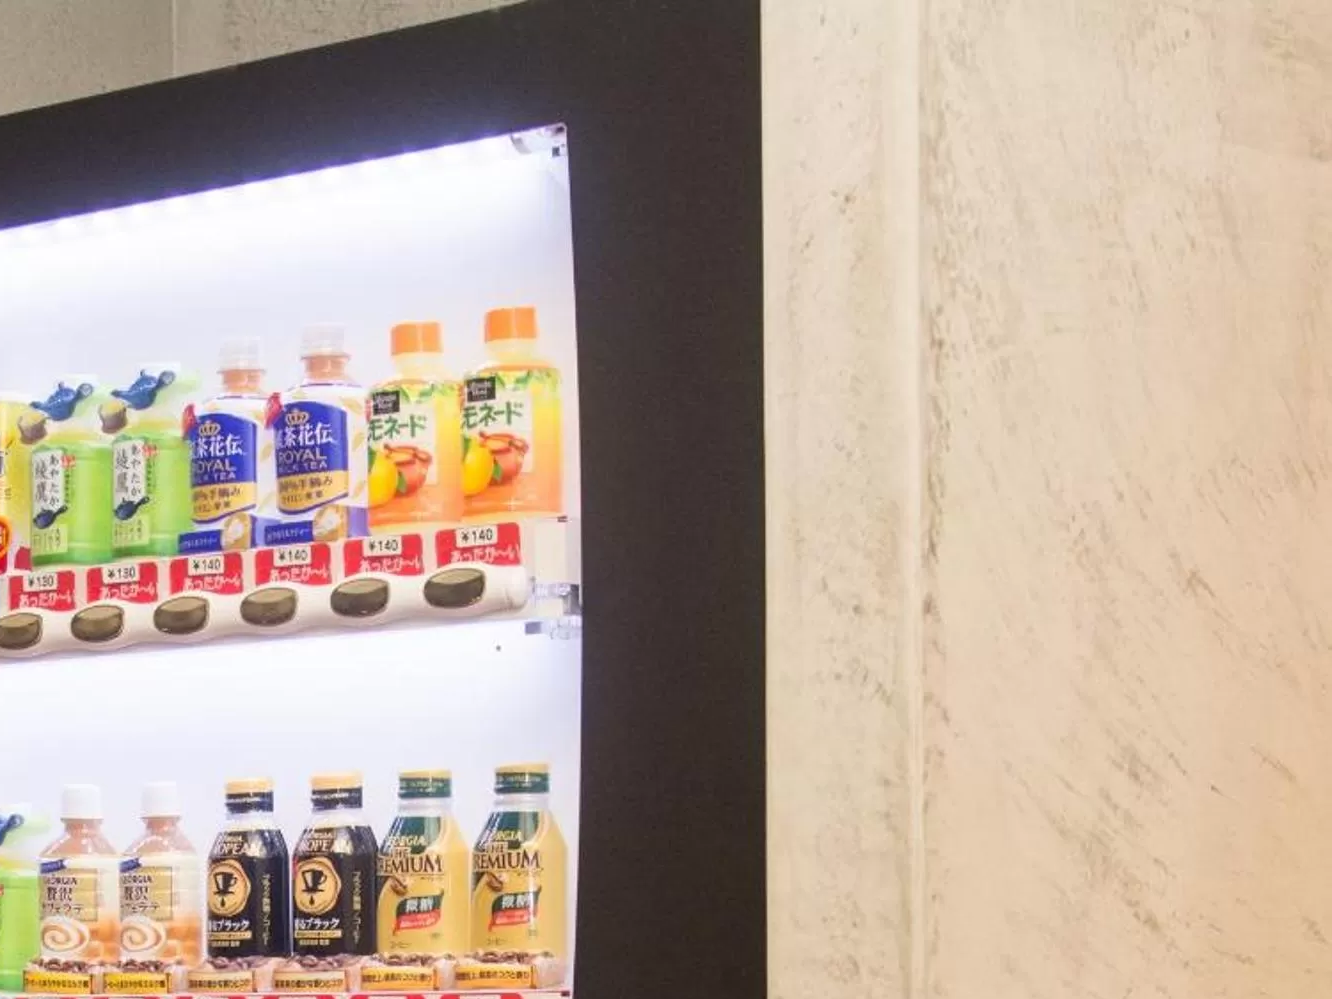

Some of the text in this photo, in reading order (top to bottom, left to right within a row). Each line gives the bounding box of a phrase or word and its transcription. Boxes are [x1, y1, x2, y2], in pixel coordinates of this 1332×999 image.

[460, 528, 494, 543] ¥140
[368, 539, 399, 552] ¥140
[278, 549, 308, 562] ¥140
[192, 558, 221, 571] ¥140
[107, 567, 136, 580] ¥130
[27, 576, 55, 588] ¥130
